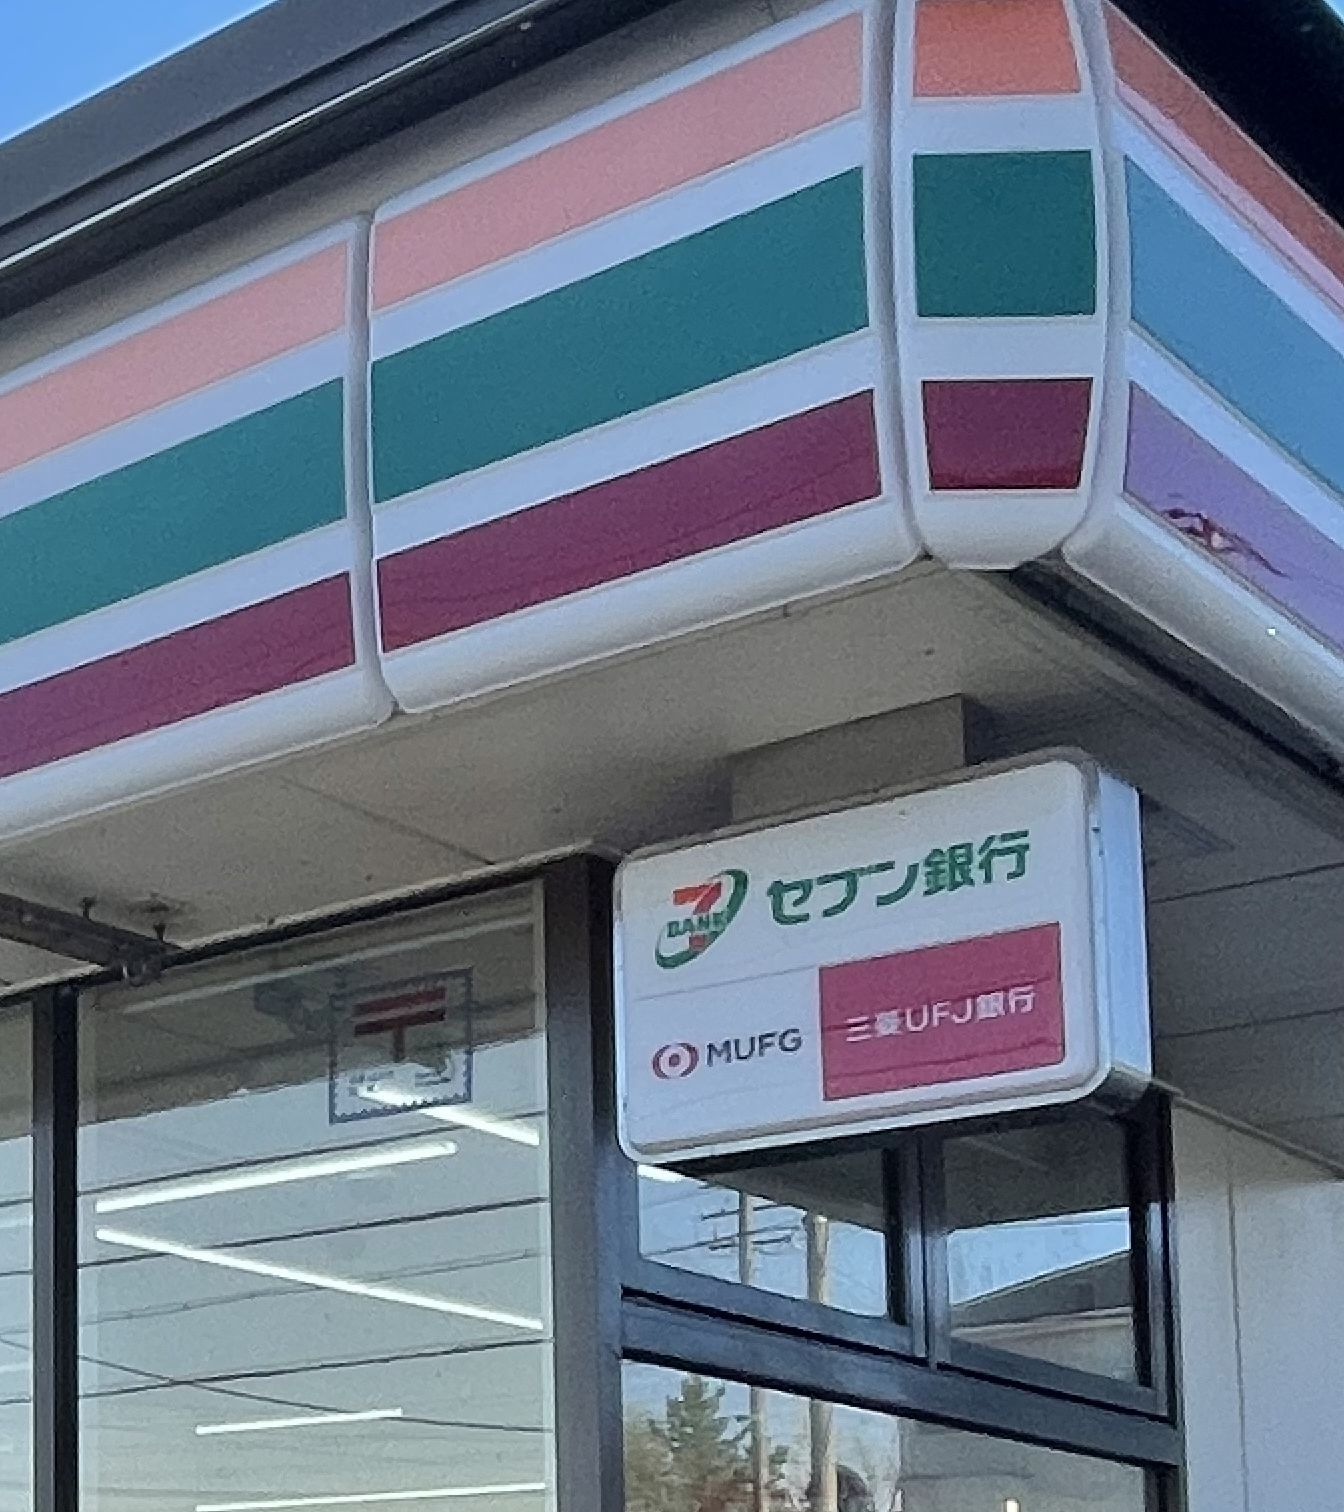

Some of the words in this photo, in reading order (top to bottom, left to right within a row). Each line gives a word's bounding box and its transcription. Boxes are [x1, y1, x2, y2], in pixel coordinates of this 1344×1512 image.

[765, 829, 1031, 926] セブン銀行
[845, 985, 1037, 1043] 三菱UFJ銀行
[706, 1028, 803, 1068] MUFG
